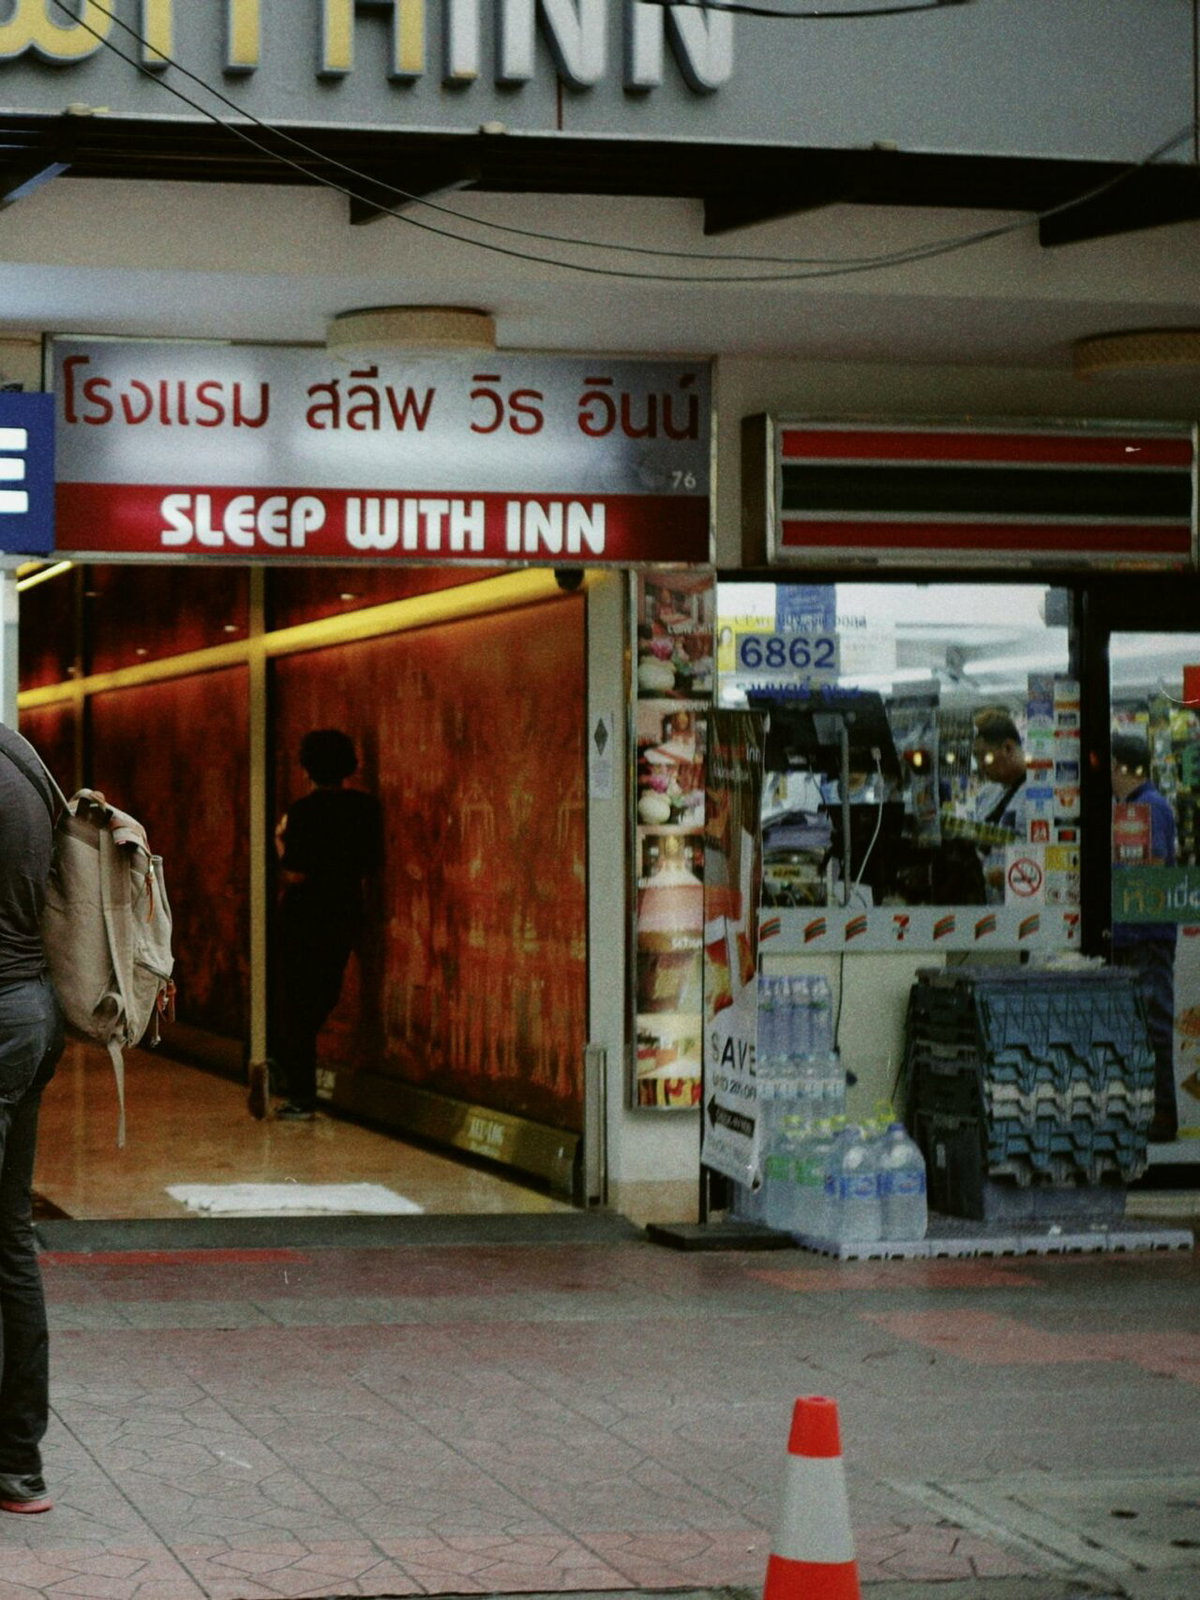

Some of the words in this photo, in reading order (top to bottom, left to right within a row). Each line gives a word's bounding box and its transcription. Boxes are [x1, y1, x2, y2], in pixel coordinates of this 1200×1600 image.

[62, 355, 270, 429] โรงแรม
[305, 365, 437, 432] สลีพ
[469, 373, 545, 436] วิธ
[577, 373, 700, 440] อินน์
[671, 470, 697, 489] 76
[159, 493, 326, 547] SLEEP
[345, 497, 485, 553] WITH
[505, 500, 606, 555] INN
[740, 637, 836, 668] 6862
[710, 1031, 757, 1077] SAVE
